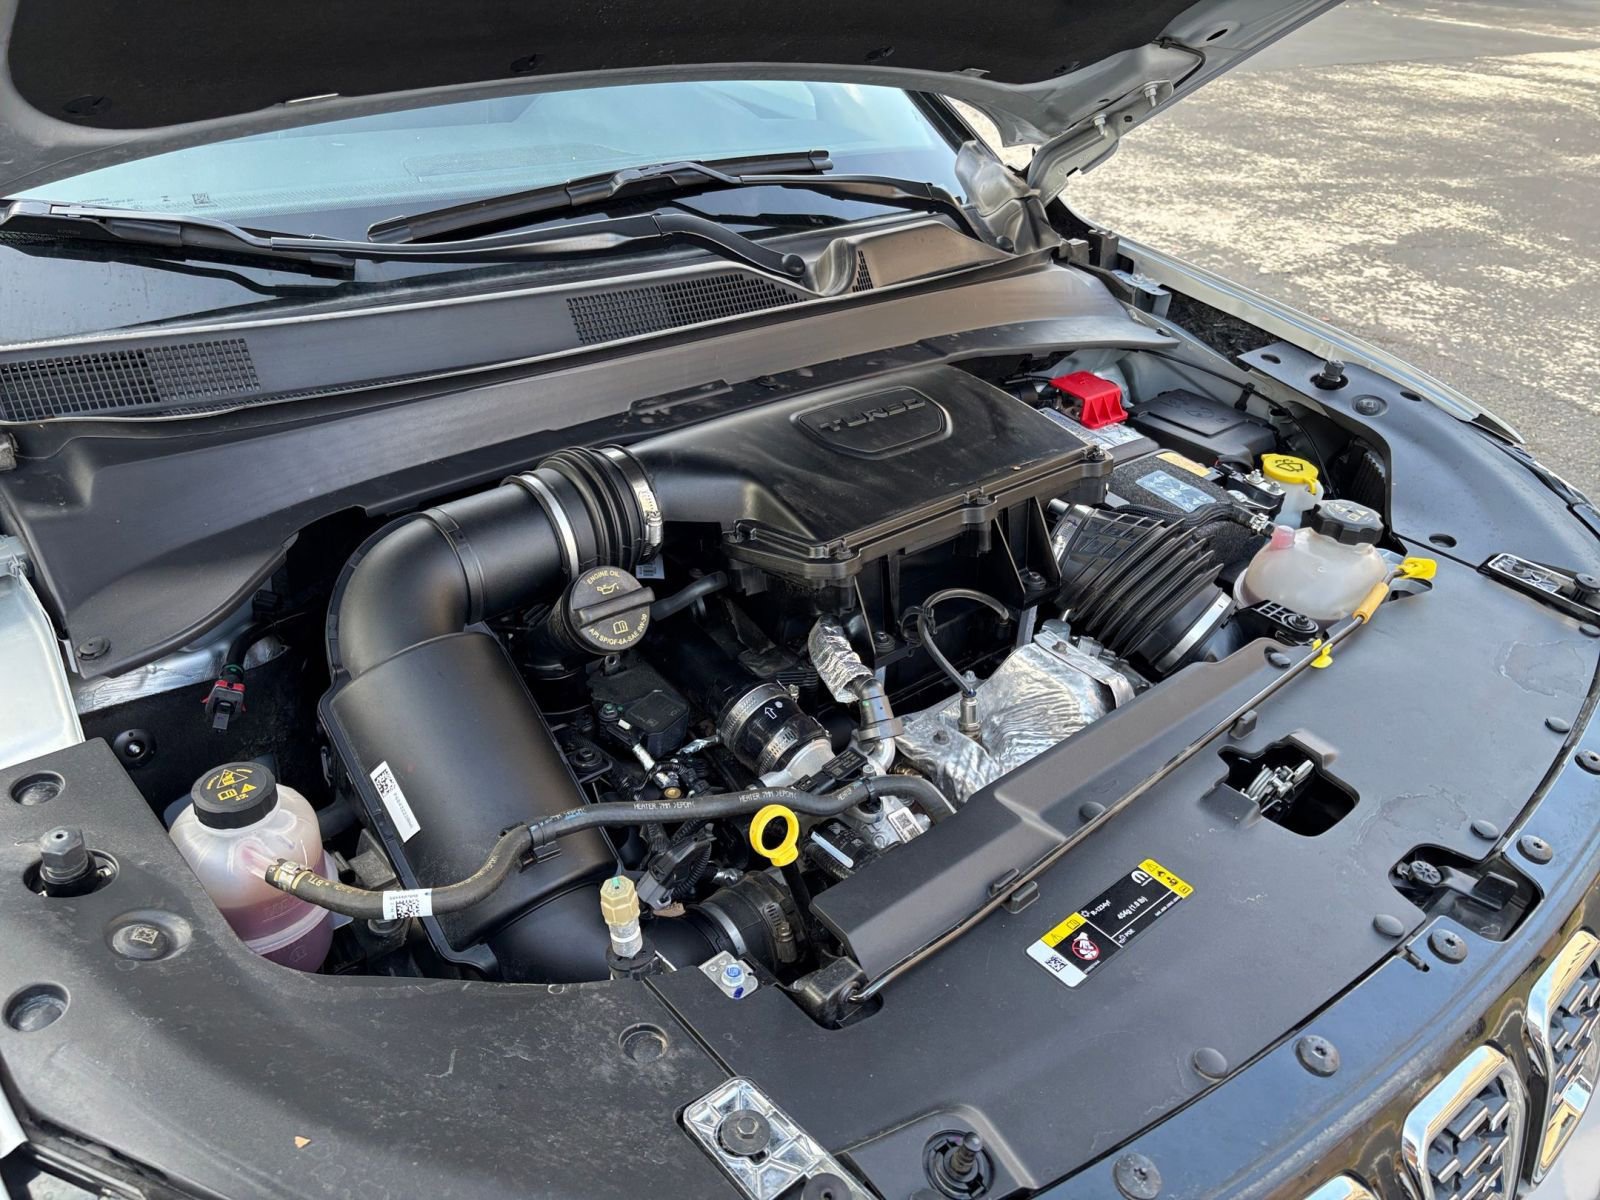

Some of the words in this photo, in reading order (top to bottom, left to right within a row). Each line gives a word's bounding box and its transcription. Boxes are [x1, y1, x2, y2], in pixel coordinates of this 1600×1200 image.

[586, 570, 609, 585] ENGINE
[609, 570, 621, 578] OIL
[589, 628, 600, 639] API
[738, 792, 760, 803] HEATER
[633, 802, 658, 810] HEATER
[308, 874, 324, 887] BTL
